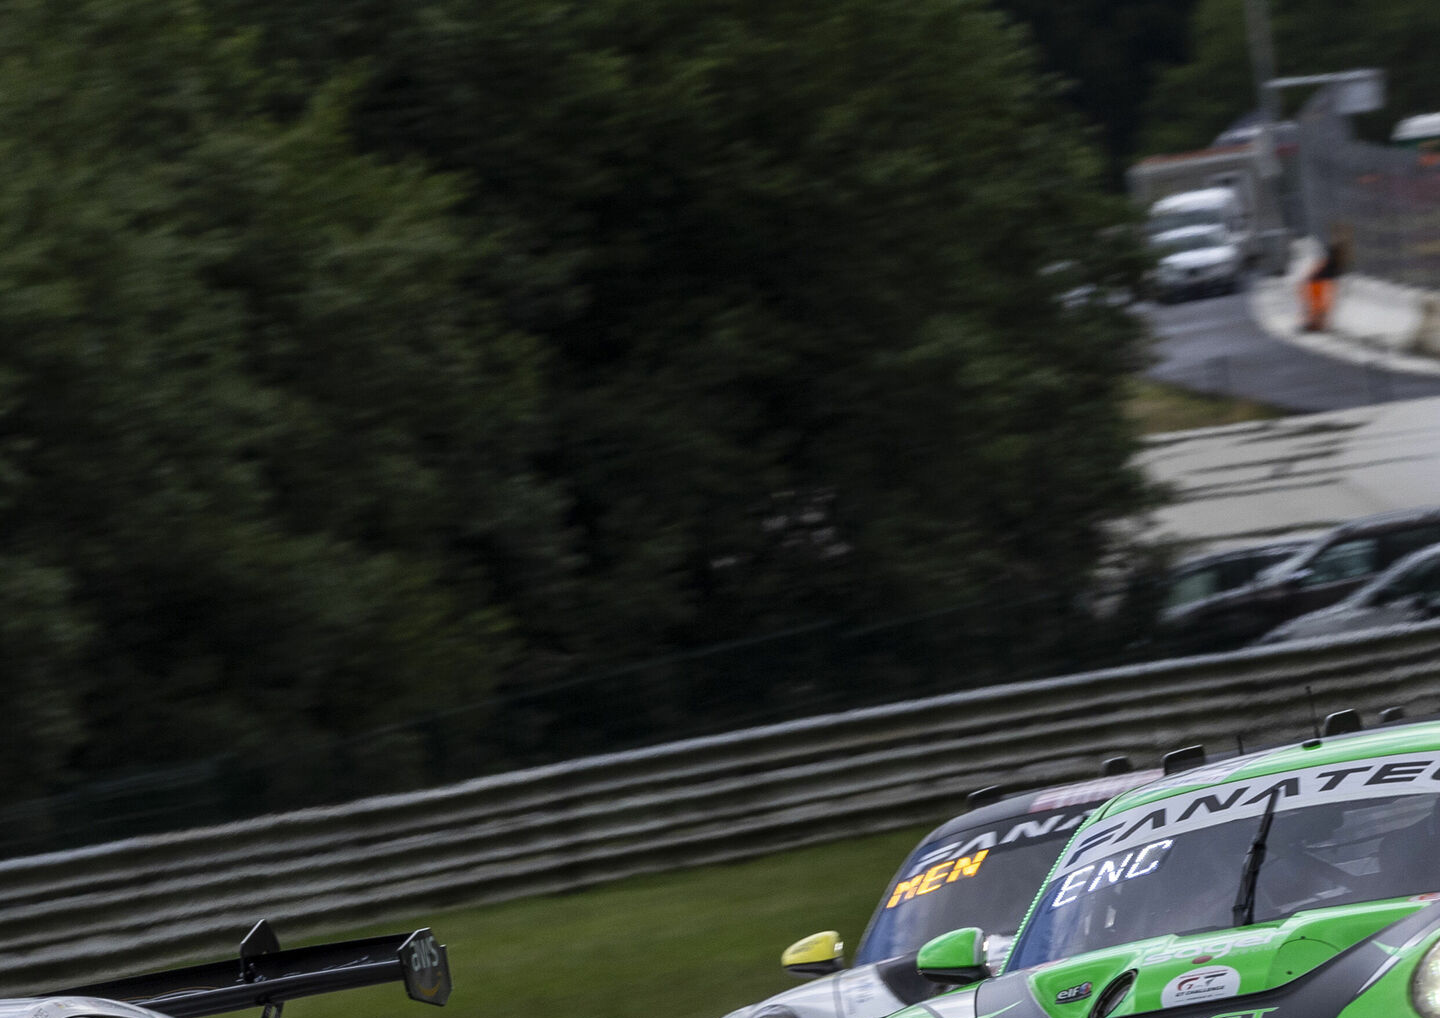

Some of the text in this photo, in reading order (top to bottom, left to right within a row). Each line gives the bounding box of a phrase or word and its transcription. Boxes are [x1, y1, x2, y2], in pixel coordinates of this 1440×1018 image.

[1064, 760, 1440, 868] FANATE
[886, 849, 989, 909] MEN
[1057, 986, 1081, 1000] elf
